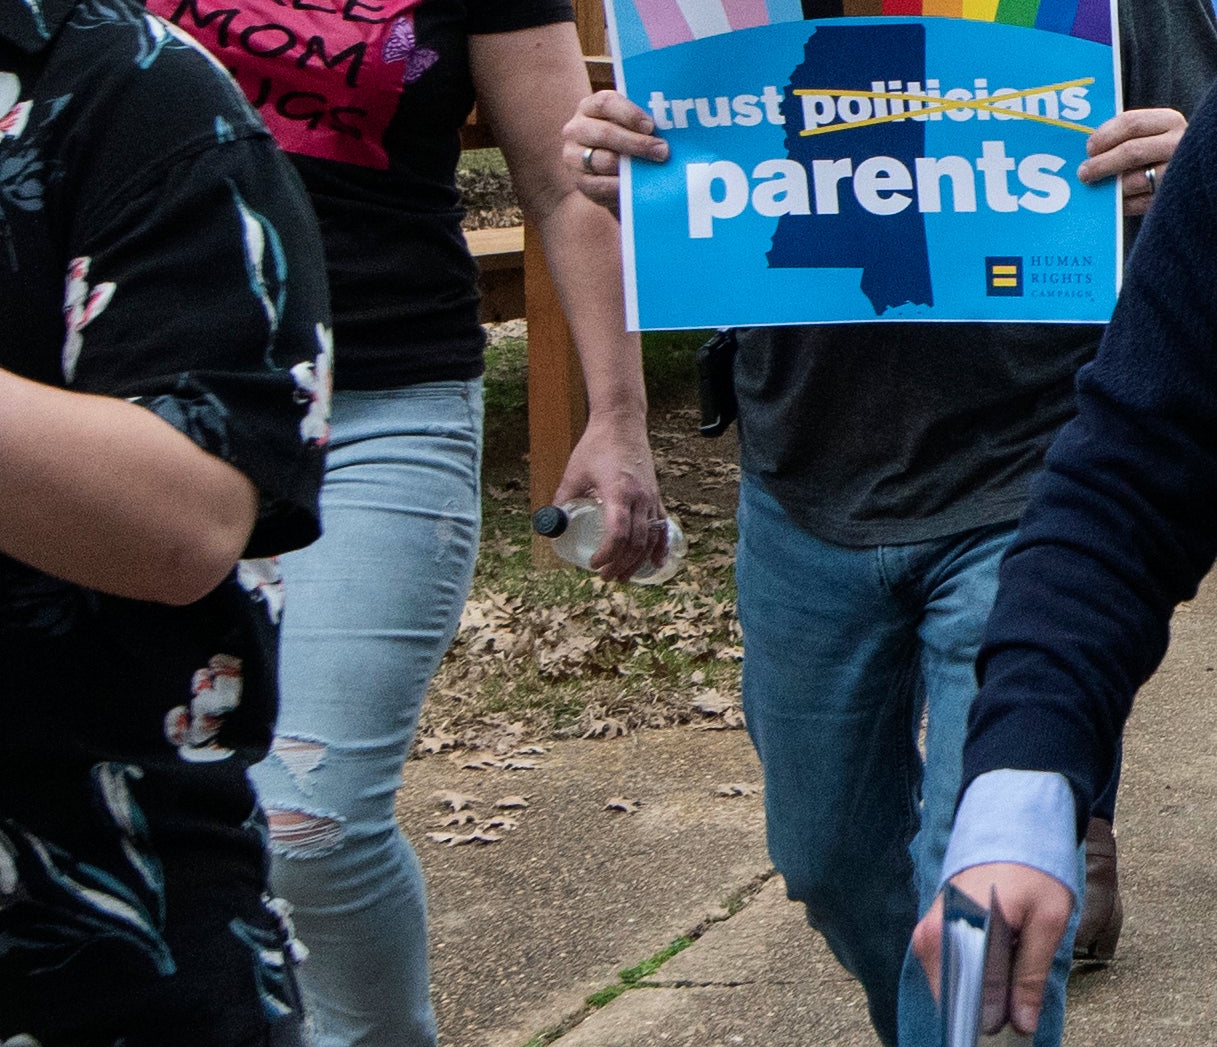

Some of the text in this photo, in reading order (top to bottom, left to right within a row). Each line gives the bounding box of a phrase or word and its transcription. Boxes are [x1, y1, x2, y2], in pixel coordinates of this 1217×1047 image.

[648, 78, 1091, 132] trust politicians
[686, 140, 1072, 239] parents
[1030, 255, 1093, 267] HUMAN
[1030, 272, 1093, 285] RIGHTS
